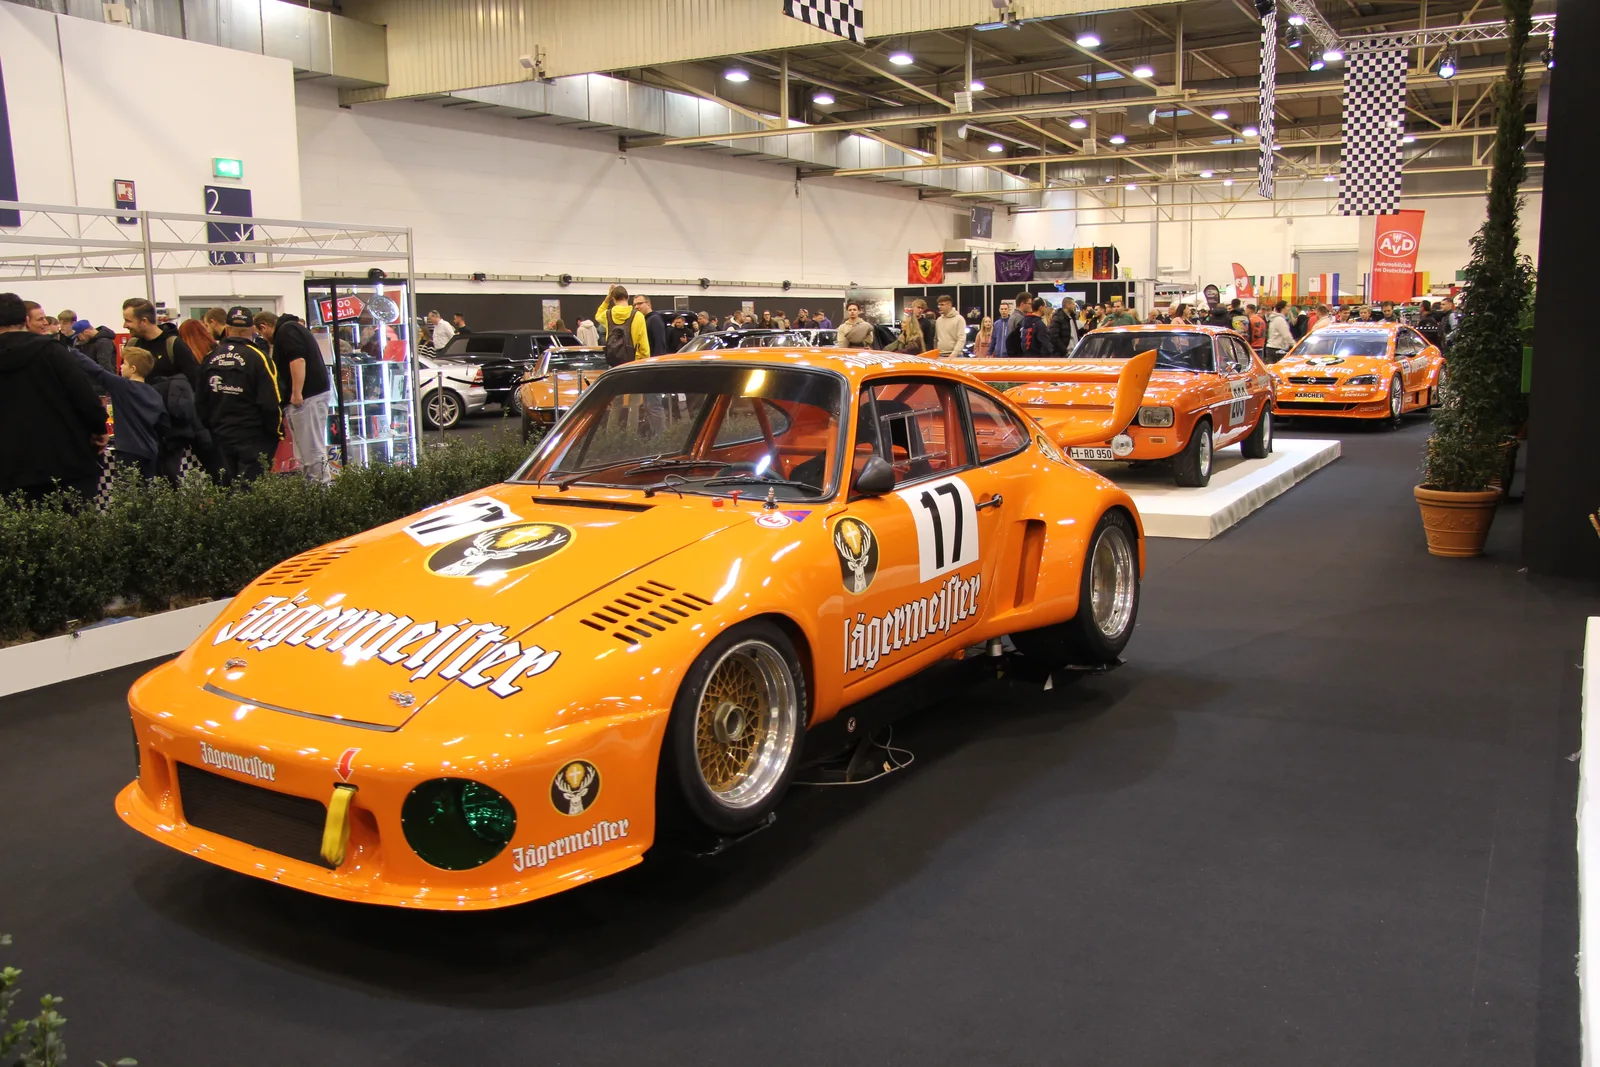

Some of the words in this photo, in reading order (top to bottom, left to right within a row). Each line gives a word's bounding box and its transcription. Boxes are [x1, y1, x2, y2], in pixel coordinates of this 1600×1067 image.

[206, 189, 222, 214] 2
[326, 300, 351, 310] 100
[327, 308, 355, 318] MGLIA
[1096, 449, 1112, 459] 950
[920, 482, 964, 570] 17
[512, 819, 630, 873] Jägermeister
